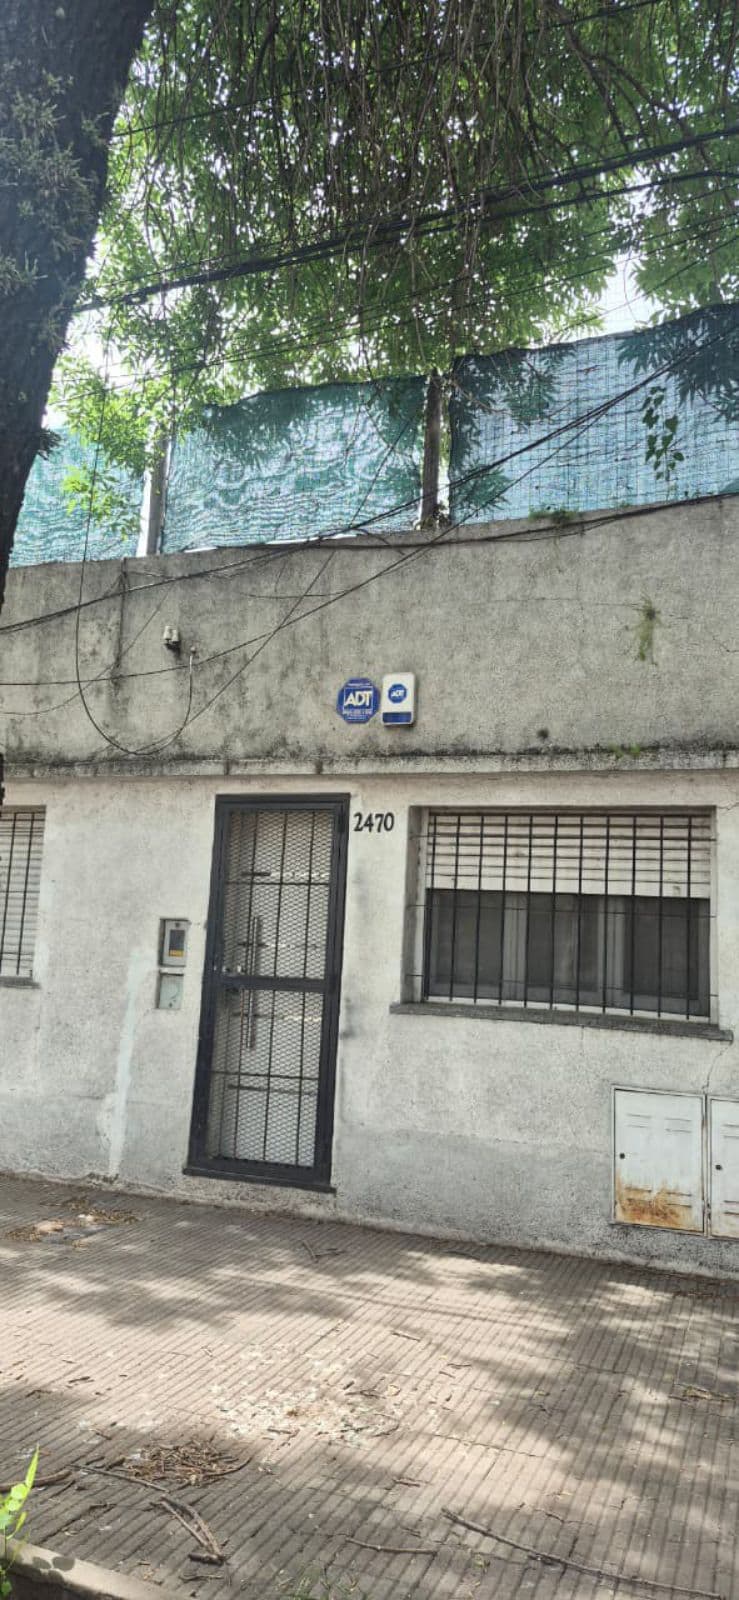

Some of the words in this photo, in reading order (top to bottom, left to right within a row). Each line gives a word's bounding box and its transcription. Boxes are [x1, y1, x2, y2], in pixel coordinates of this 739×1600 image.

[344, 691, 373, 707] ADT
[391, 689, 405, 697] ADT
[353, 812, 395, 833] 2470
